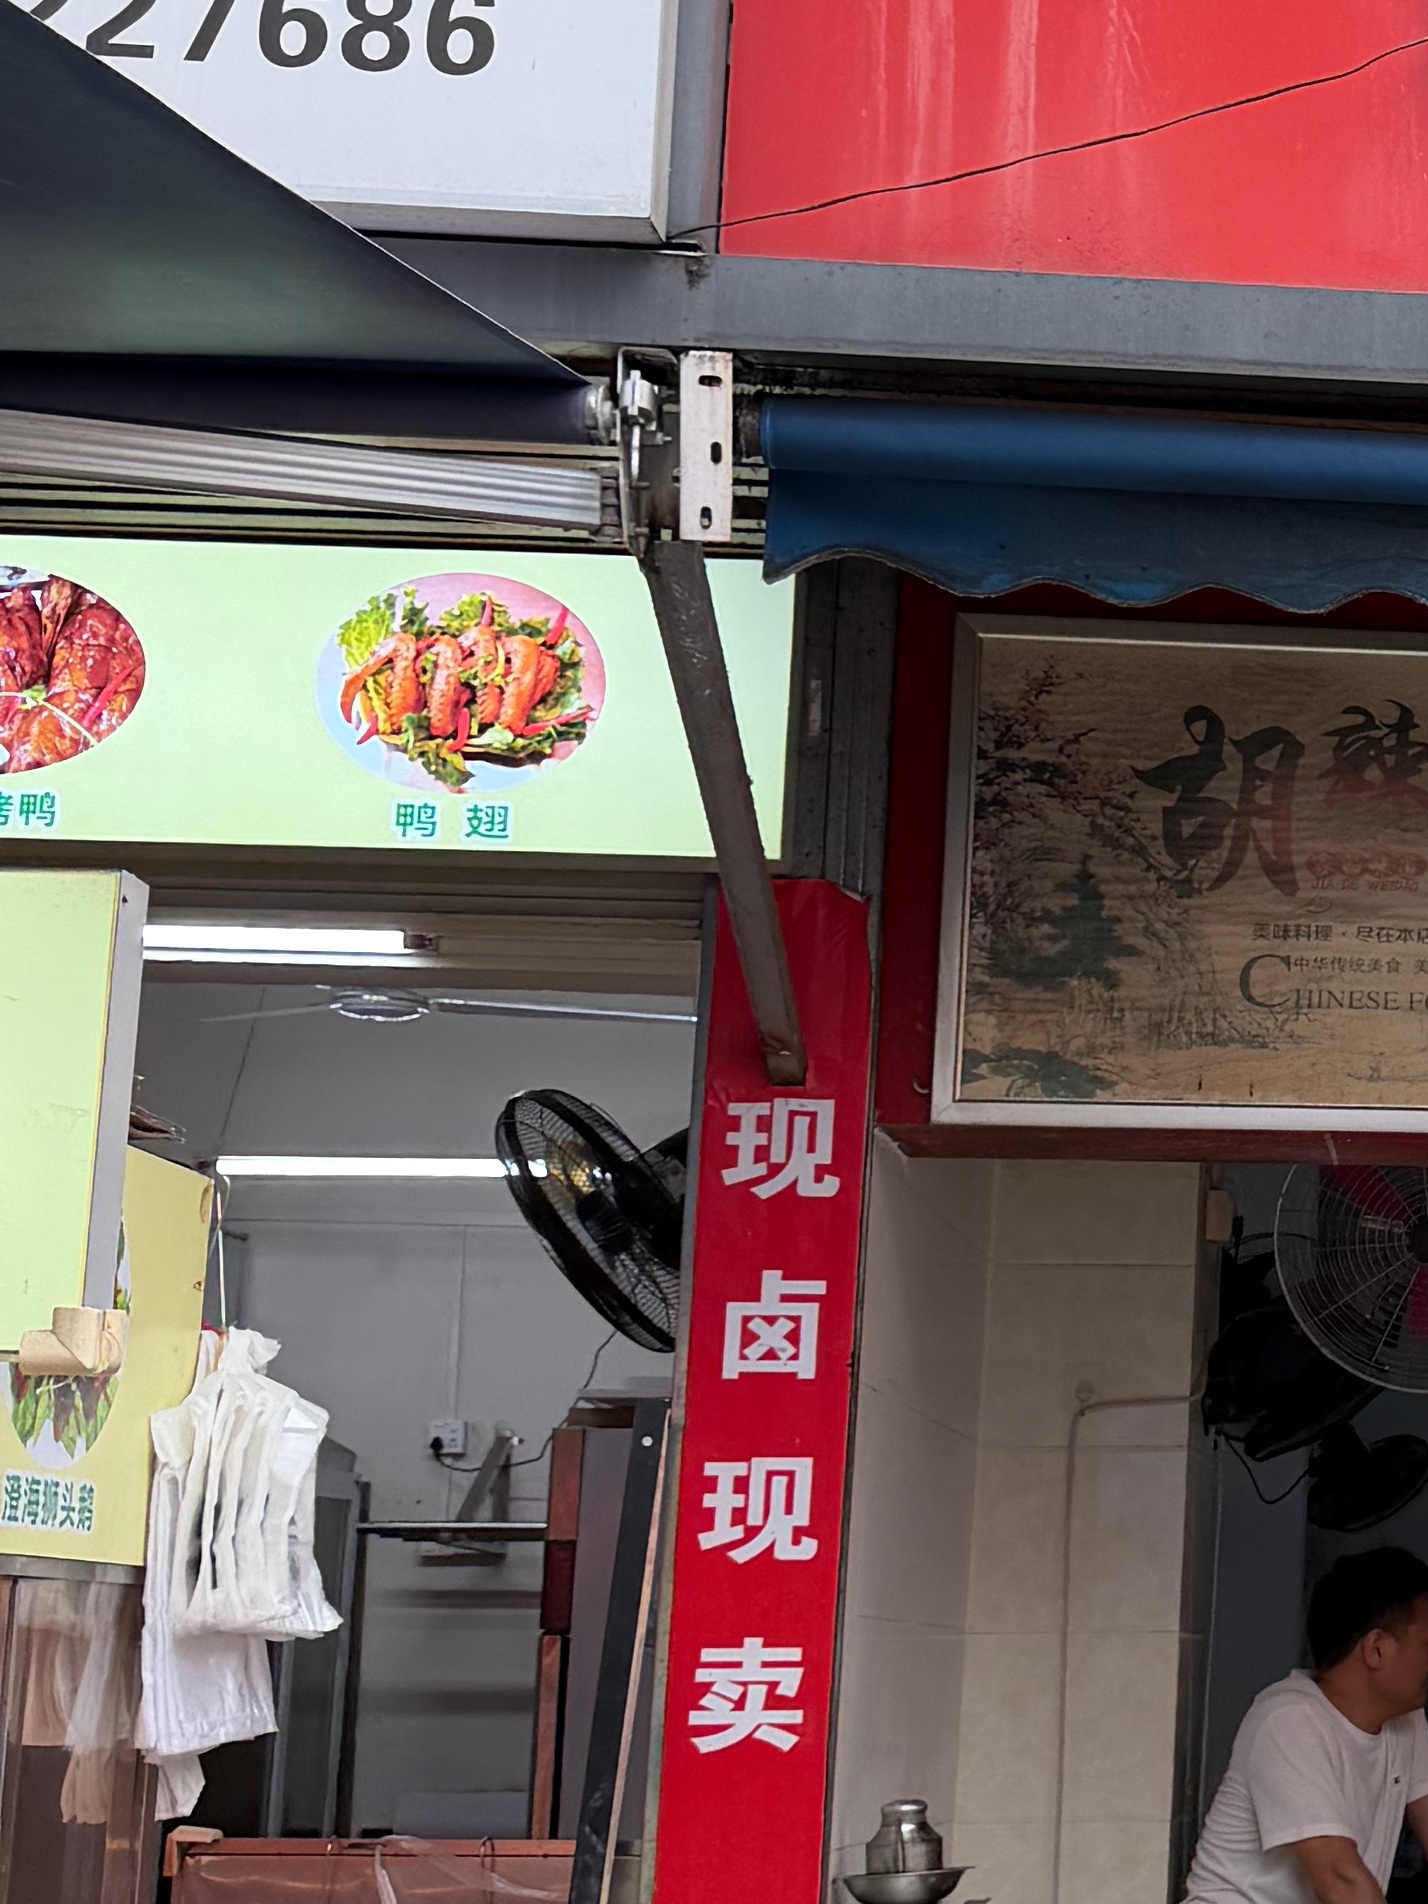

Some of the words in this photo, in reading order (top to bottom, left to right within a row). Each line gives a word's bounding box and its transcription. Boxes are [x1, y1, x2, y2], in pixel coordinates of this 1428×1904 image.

[394, 802, 512, 839] 鸭翅
[1239, 953, 1401, 1011] CHINESE
[1294, 957, 1402, 975] 中华传统美食
[687, 1098, 841, 1755] 现卤现卖
